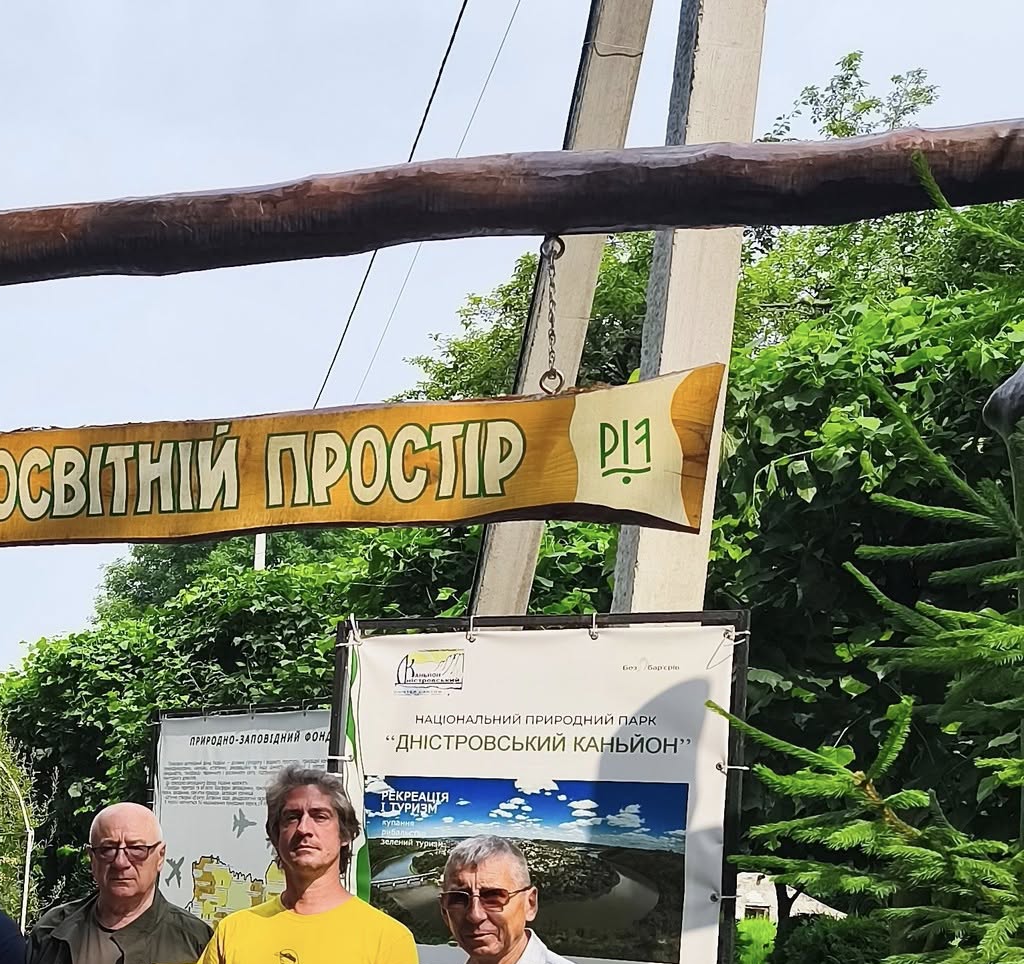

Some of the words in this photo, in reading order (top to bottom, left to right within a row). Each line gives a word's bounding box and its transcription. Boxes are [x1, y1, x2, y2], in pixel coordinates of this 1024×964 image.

[266, 419, 527, 509] ПРОСТІР
[415, 714, 521, 726] НАЦІОНАЛЬНИЙ
[525, 714, 614, 727] ПРИРОДНИЙ
[618, 715, 657, 727] ПАРК
[189, 730, 301, 747] ПРИРОДНО-ЗАПОВІДНИЙ
[381, 791, 449, 804] РЕКРЕАЦІЯ
[389, 802, 438, 814] ТУРИЗМ
[381, 820, 415, 828] купання
[380, 838, 414, 846] зелений
